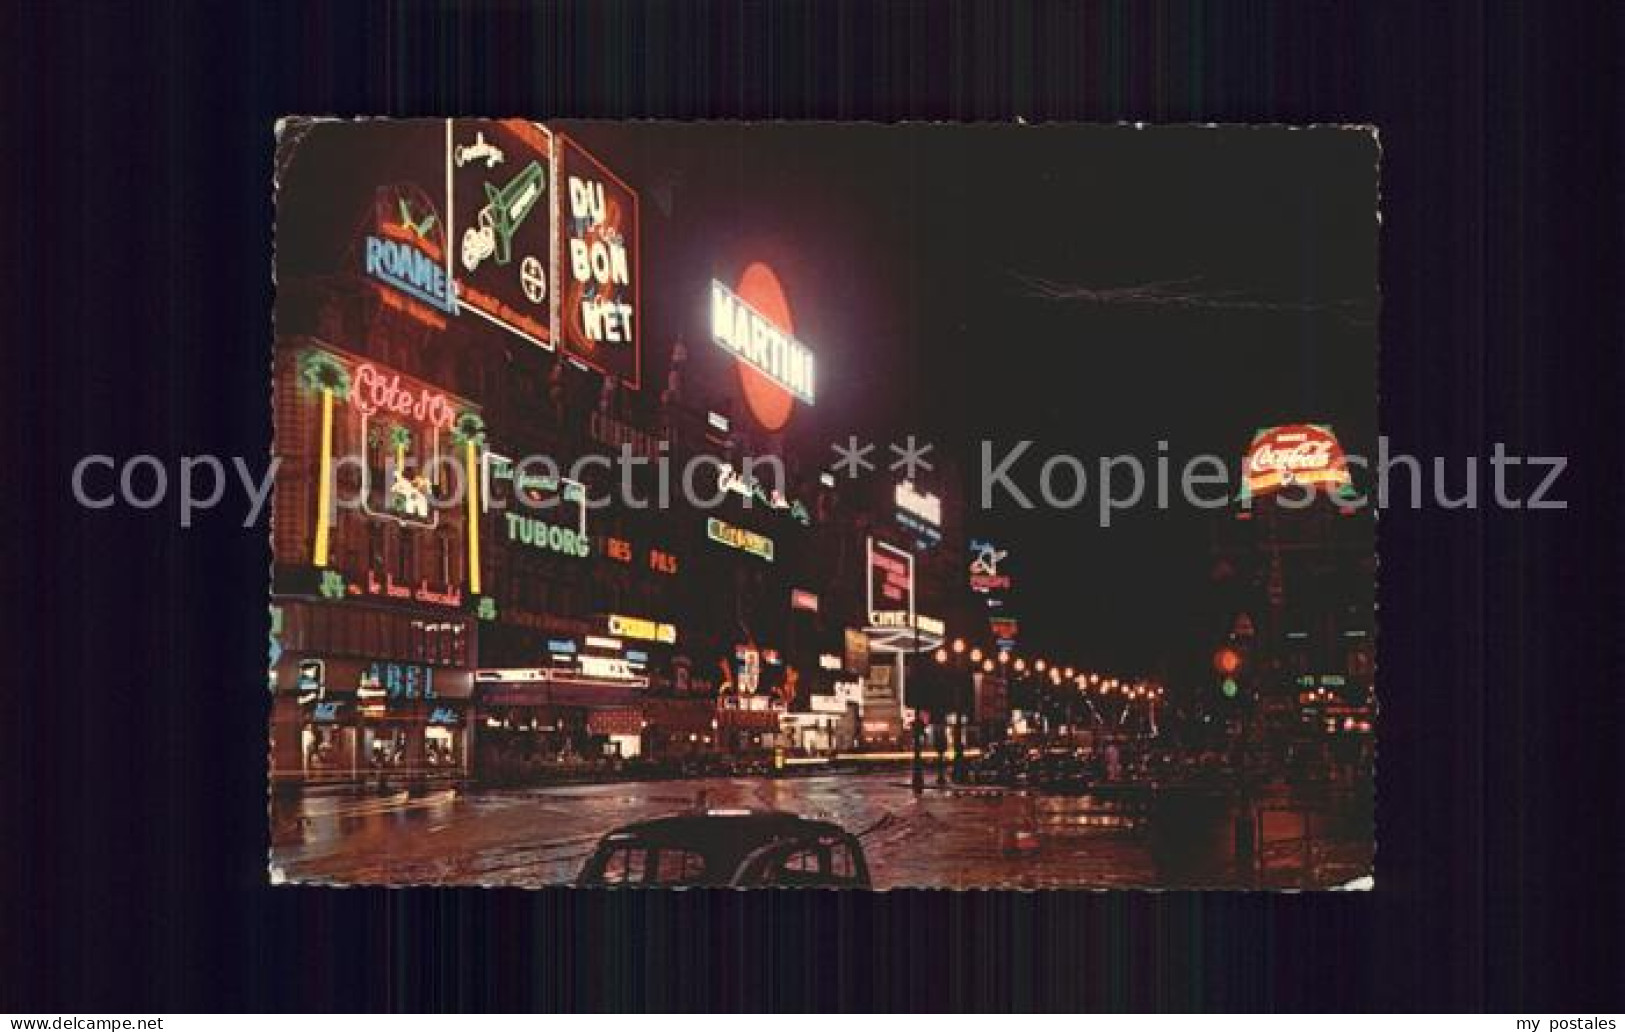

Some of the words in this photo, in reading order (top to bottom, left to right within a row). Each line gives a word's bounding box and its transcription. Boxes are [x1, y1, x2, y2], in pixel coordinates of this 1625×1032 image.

[569, 176, 606, 224] DU
[570, 238, 629, 285] BON
[582, 301, 633, 342] NET
[712, 284, 814, 402] MARTINI
[505, 513, 591, 558] TUBORG
